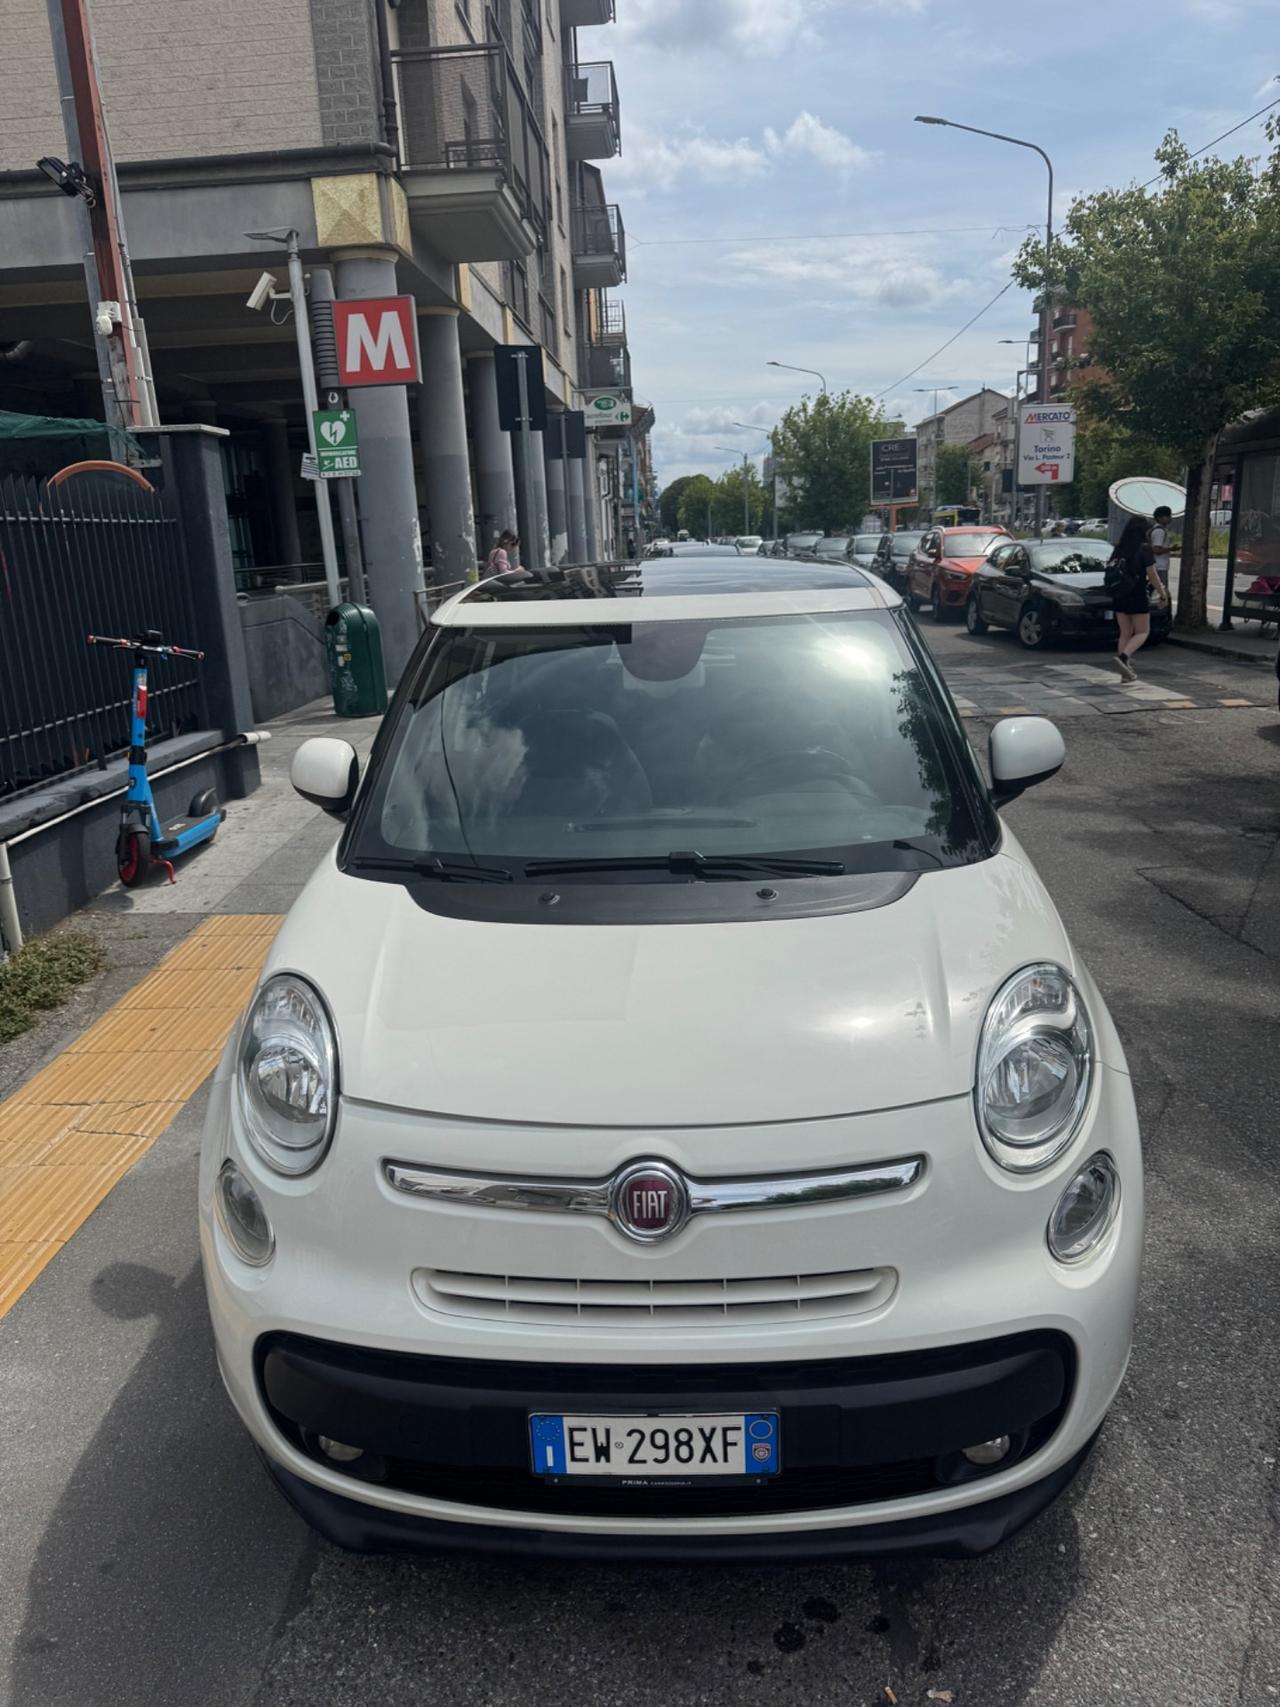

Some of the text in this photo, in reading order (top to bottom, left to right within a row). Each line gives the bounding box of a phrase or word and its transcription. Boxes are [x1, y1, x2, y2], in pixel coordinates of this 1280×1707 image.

[346, 310, 411, 372] M
[1024, 412, 1070, 424] MERCATO
[1034, 444, 1061, 453] Torino
[334, 456, 358, 469] AED
[633, 1191, 667, 1218] FIAT
[568, 1426, 741, 1464] EW 298XF
